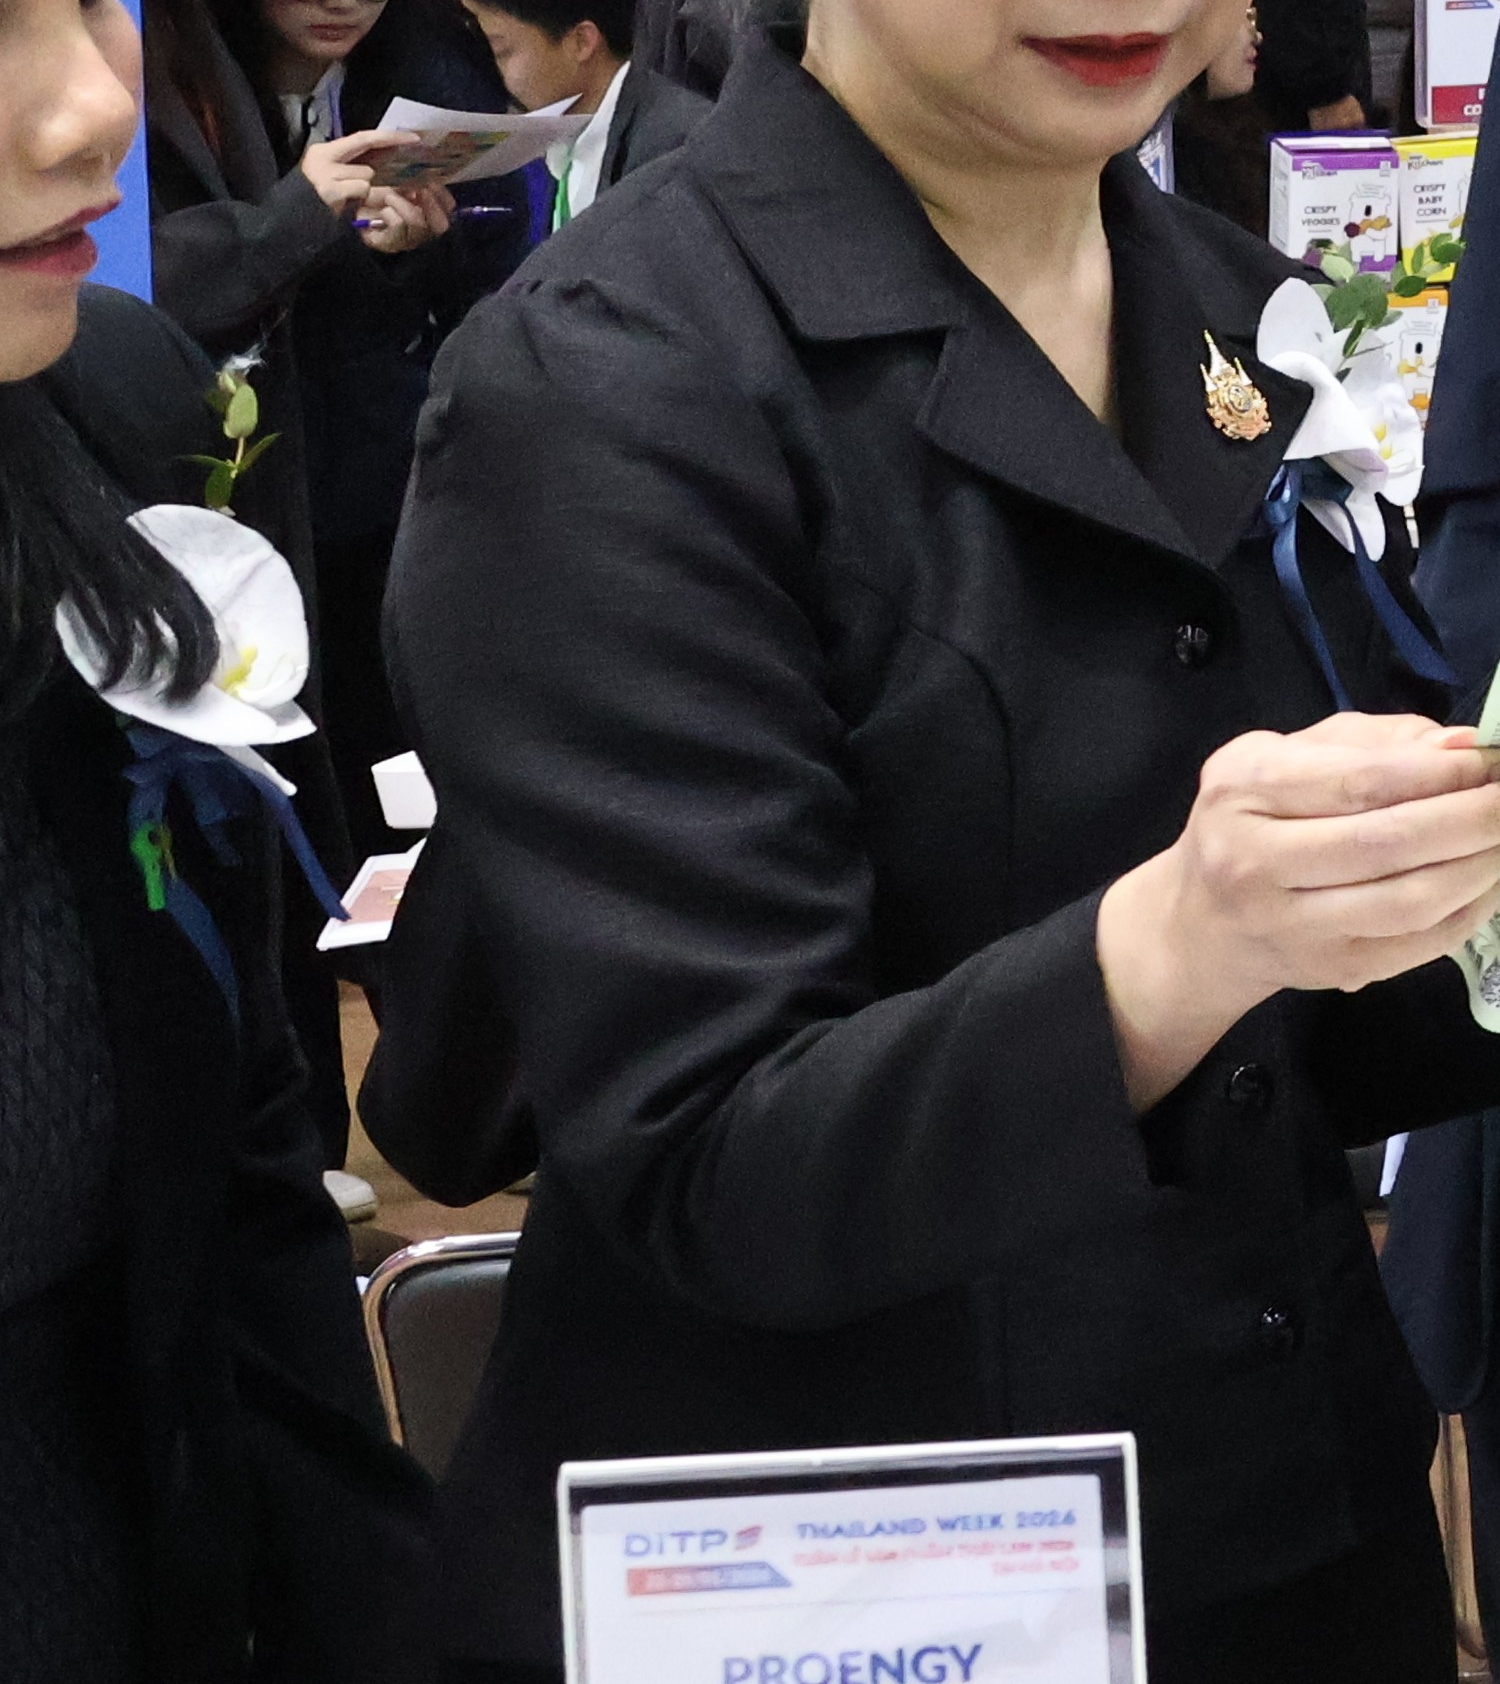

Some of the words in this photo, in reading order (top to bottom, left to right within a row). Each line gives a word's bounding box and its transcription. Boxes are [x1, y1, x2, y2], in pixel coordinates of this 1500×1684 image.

[1413, 184, 1446, 193] CRISPY
[1418, 196, 1443, 204] BABY
[1417, 207, 1447, 216] CORN
[624, 1529, 727, 1557] DITP
[721, 1644, 984, 1684] PROENGY
